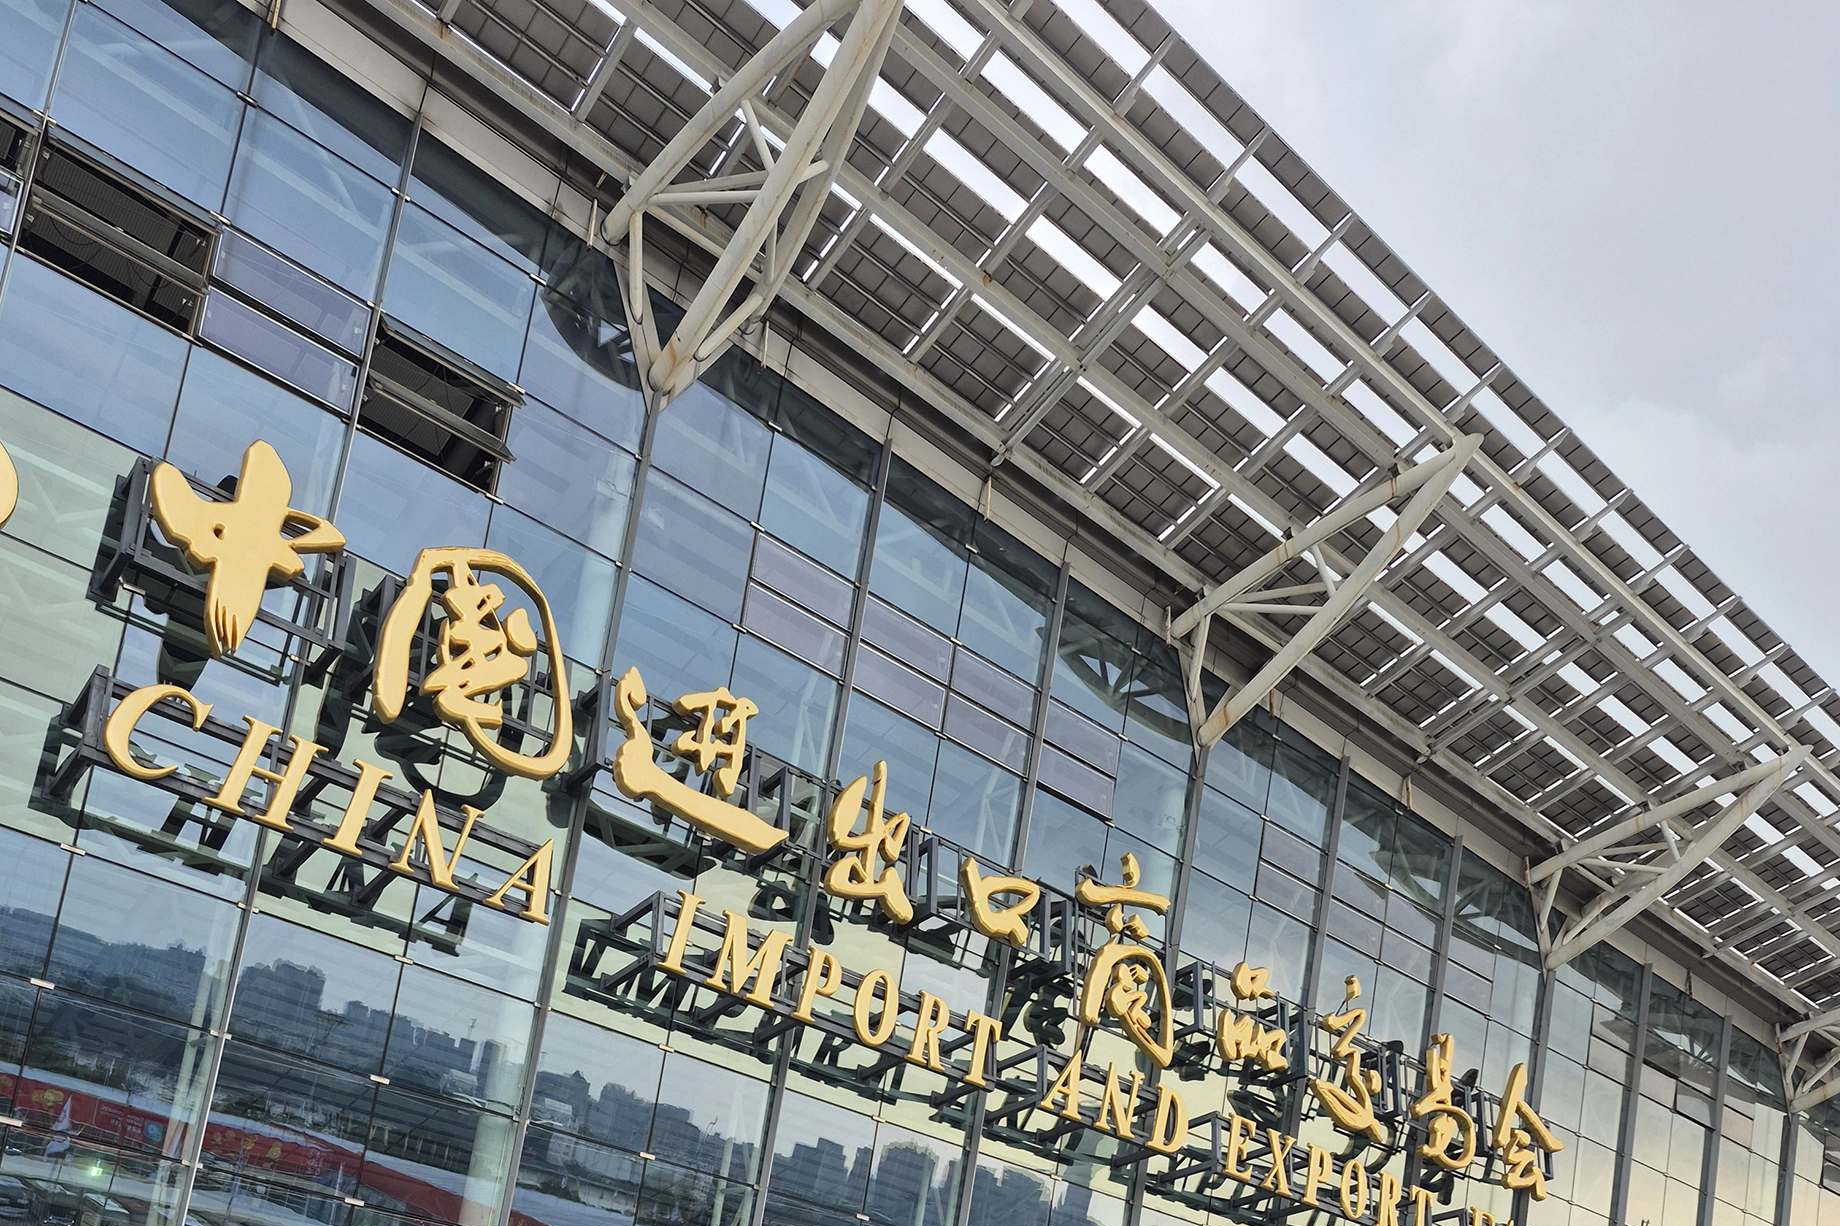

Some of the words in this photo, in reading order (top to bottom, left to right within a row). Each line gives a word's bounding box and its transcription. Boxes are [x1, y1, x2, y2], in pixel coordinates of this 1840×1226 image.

[104, 684, 551, 925] CHINA
[657, 888, 1003, 1089] IMPORT
[1040, 1049, 1190, 1155] AND
